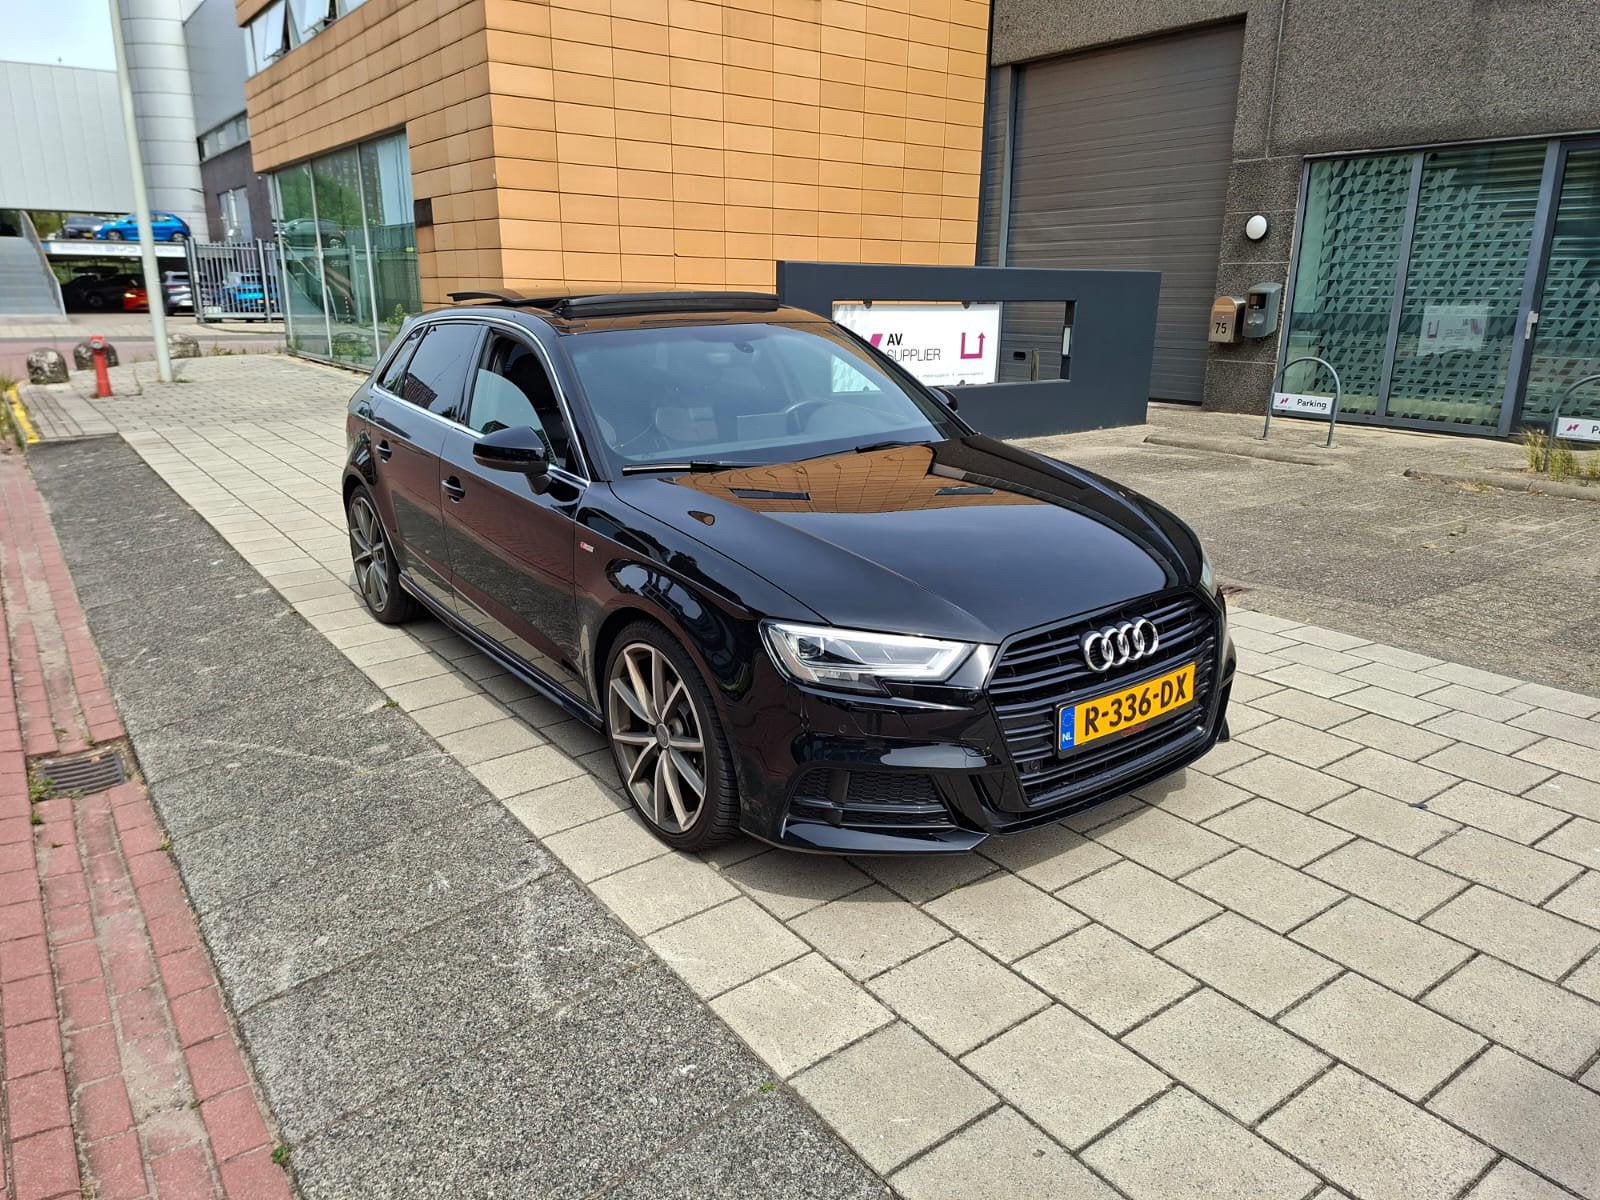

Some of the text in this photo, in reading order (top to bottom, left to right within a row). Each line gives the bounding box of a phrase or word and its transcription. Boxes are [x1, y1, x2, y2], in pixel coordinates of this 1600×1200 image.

[1215, 322, 1227, 334] 75
[886, 348, 941, 362] SUPPLIER
[1296, 398, 1328, 411] Parking
[1084, 672, 1188, 736] R-336-DX
[1062, 732, 1073, 742] NL
